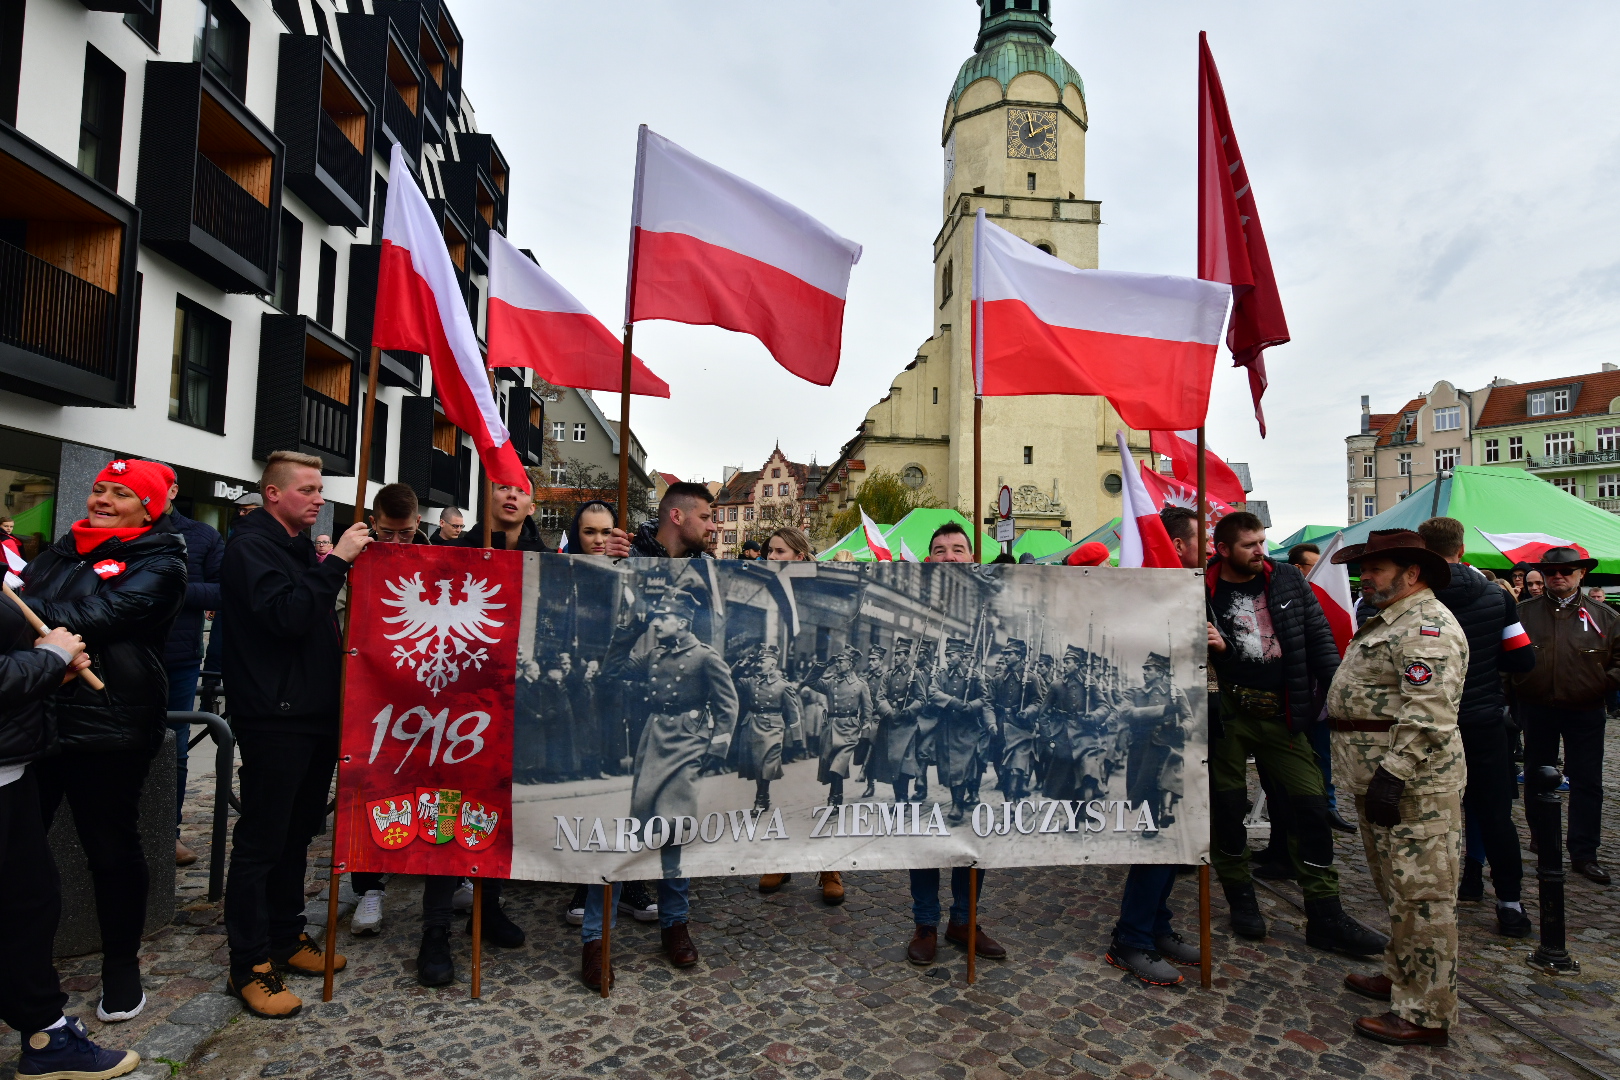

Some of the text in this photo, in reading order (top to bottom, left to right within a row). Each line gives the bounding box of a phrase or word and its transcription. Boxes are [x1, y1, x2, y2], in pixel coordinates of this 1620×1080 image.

[368, 704, 491, 774] 1918
[553, 800, 1159, 853] NARODOWA ZIEMIA OJCZYSTA
